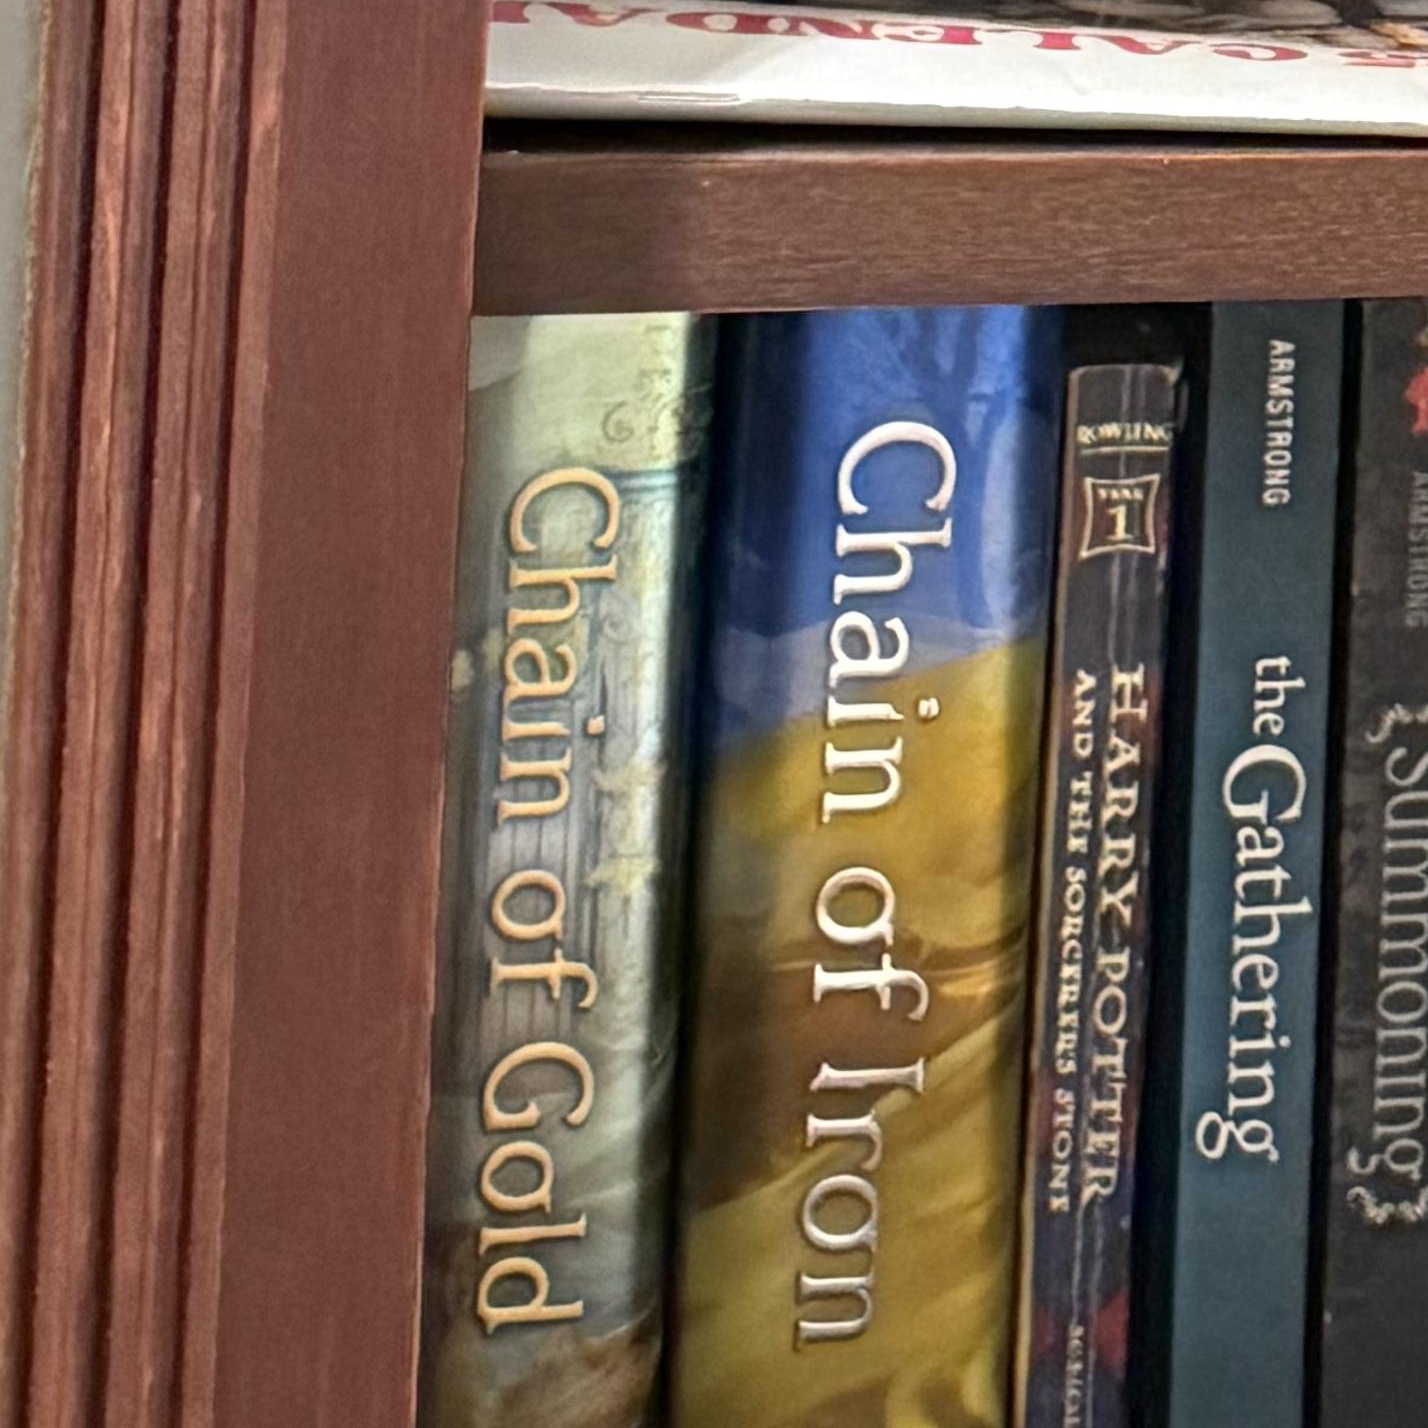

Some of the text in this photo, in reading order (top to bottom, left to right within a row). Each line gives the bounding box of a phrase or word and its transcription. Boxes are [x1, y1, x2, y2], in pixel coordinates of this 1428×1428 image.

[489, 0, 1307, 61] CALENDA
[1262, 340, 1295, 508] ARMSTRONG
[1106, 504, 1133, 540] 1
[1072, 668, 1097, 758] AND
[798, 420, 957, 1342] Chain of Iron
[1067, 771, 1093, 854] THE
[475, 466, 622, 1335] Chain of Gold
[1081, 663, 1148, 1204] HARRY POTTER
[1195, 655, 1313, 1164] the Gathering
[1049, 1087, 1074, 1213] STONE
